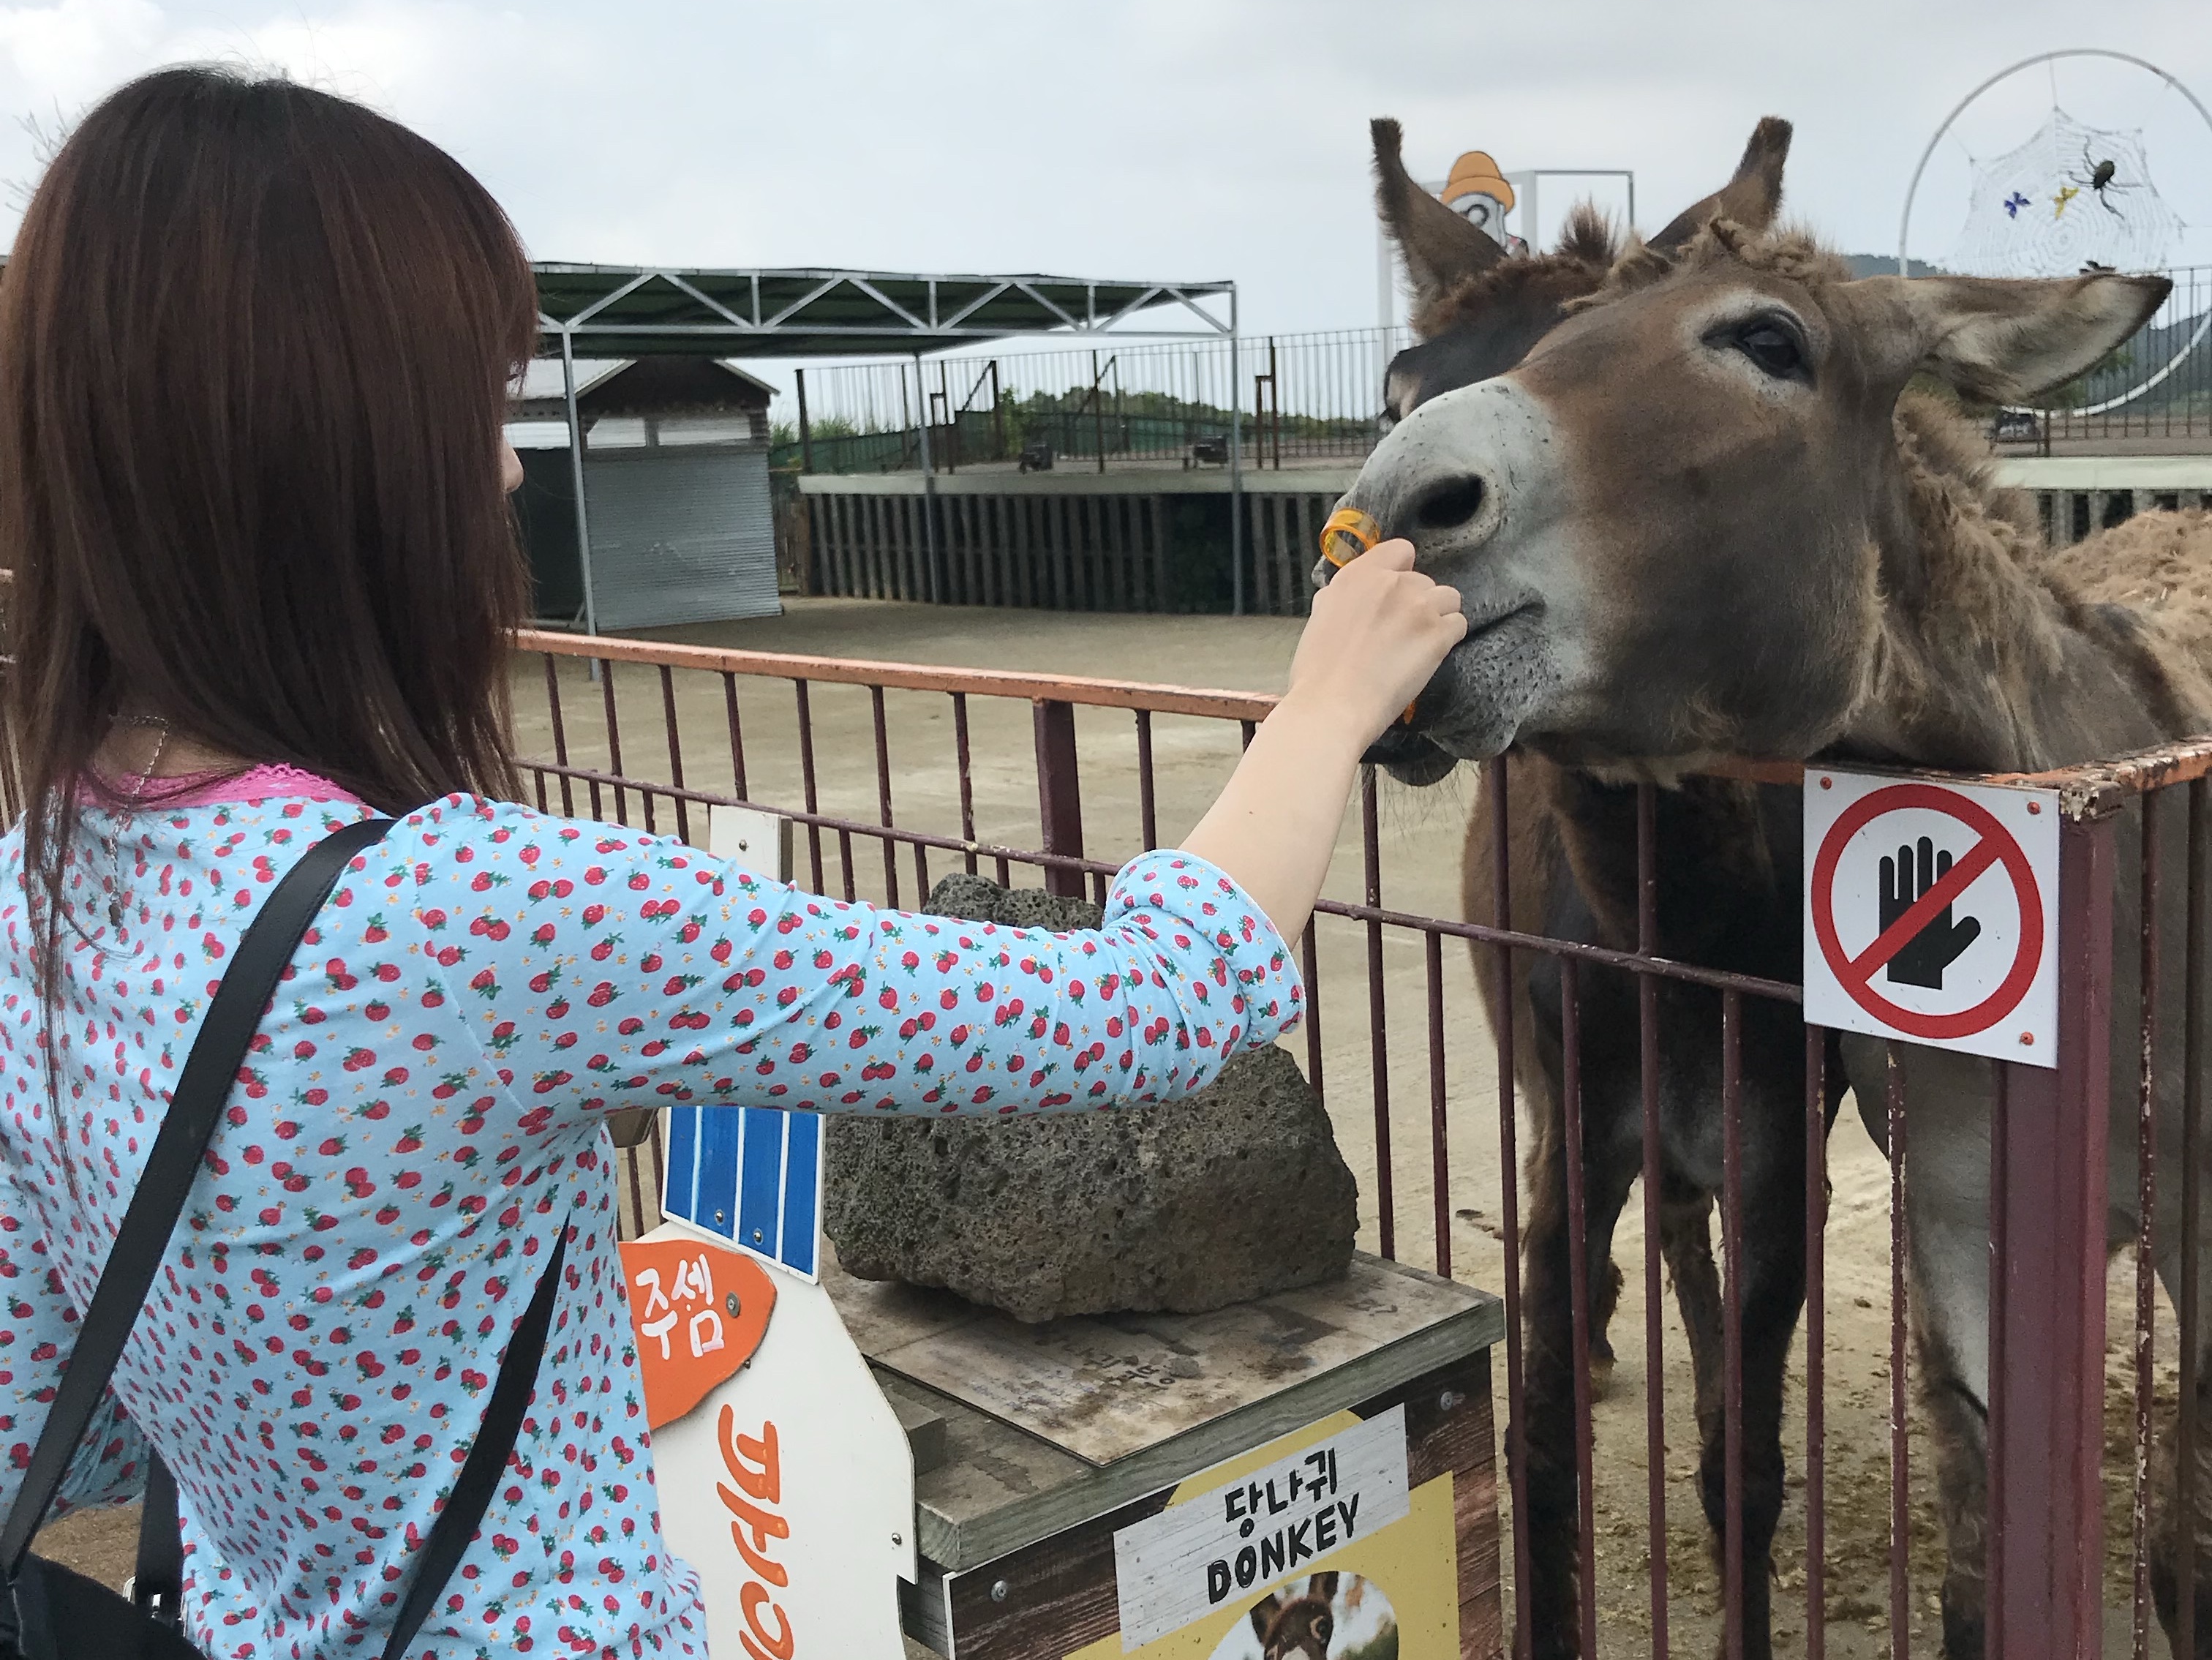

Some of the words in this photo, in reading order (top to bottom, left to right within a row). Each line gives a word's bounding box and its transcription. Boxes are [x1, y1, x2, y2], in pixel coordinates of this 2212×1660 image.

[636, 1253, 725, 1361] 주셈
[1224, 1447, 1338, 1539] 당나귀
[1207, 1492, 1360, 1605] DONKEY
